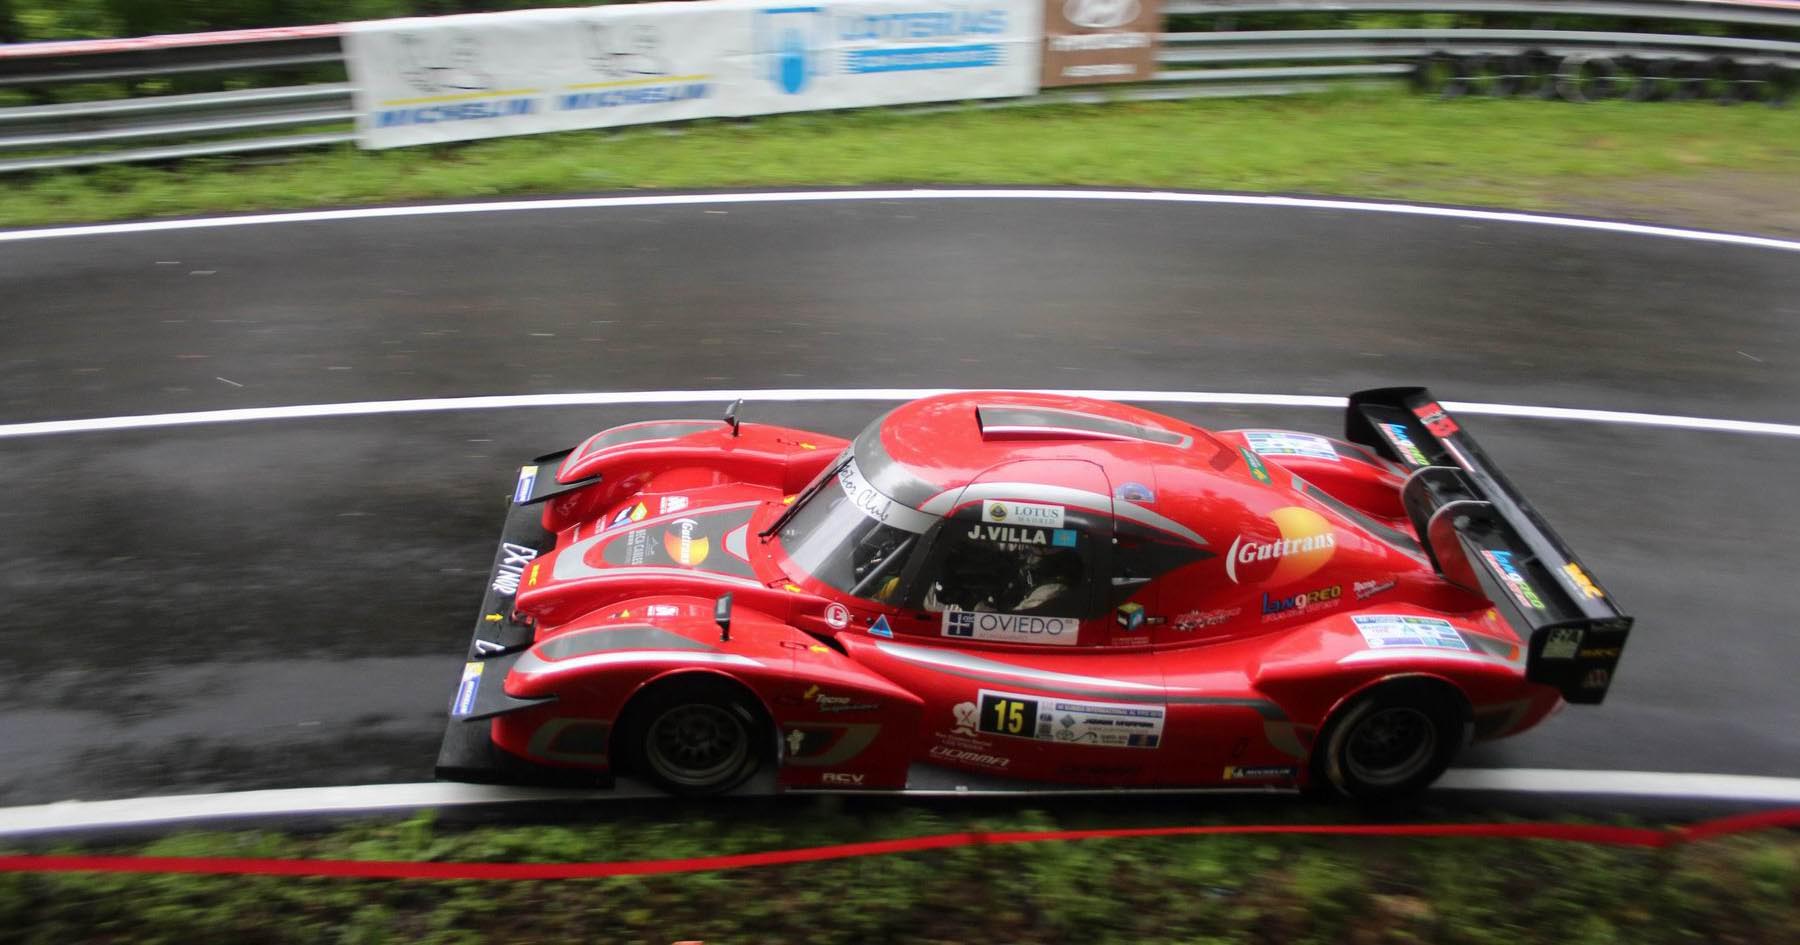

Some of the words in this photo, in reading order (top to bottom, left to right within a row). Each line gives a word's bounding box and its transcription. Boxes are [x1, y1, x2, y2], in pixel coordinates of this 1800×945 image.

[857, 489, 891, 521] Club
[1014, 506, 1059, 518] LOTUS
[967, 524, 1047, 545] J.VILLA
[1238, 532, 1335, 564] Guttrans
[979, 614, 1064, 635] OVIEDO
[994, 700, 1025, 733] 15
